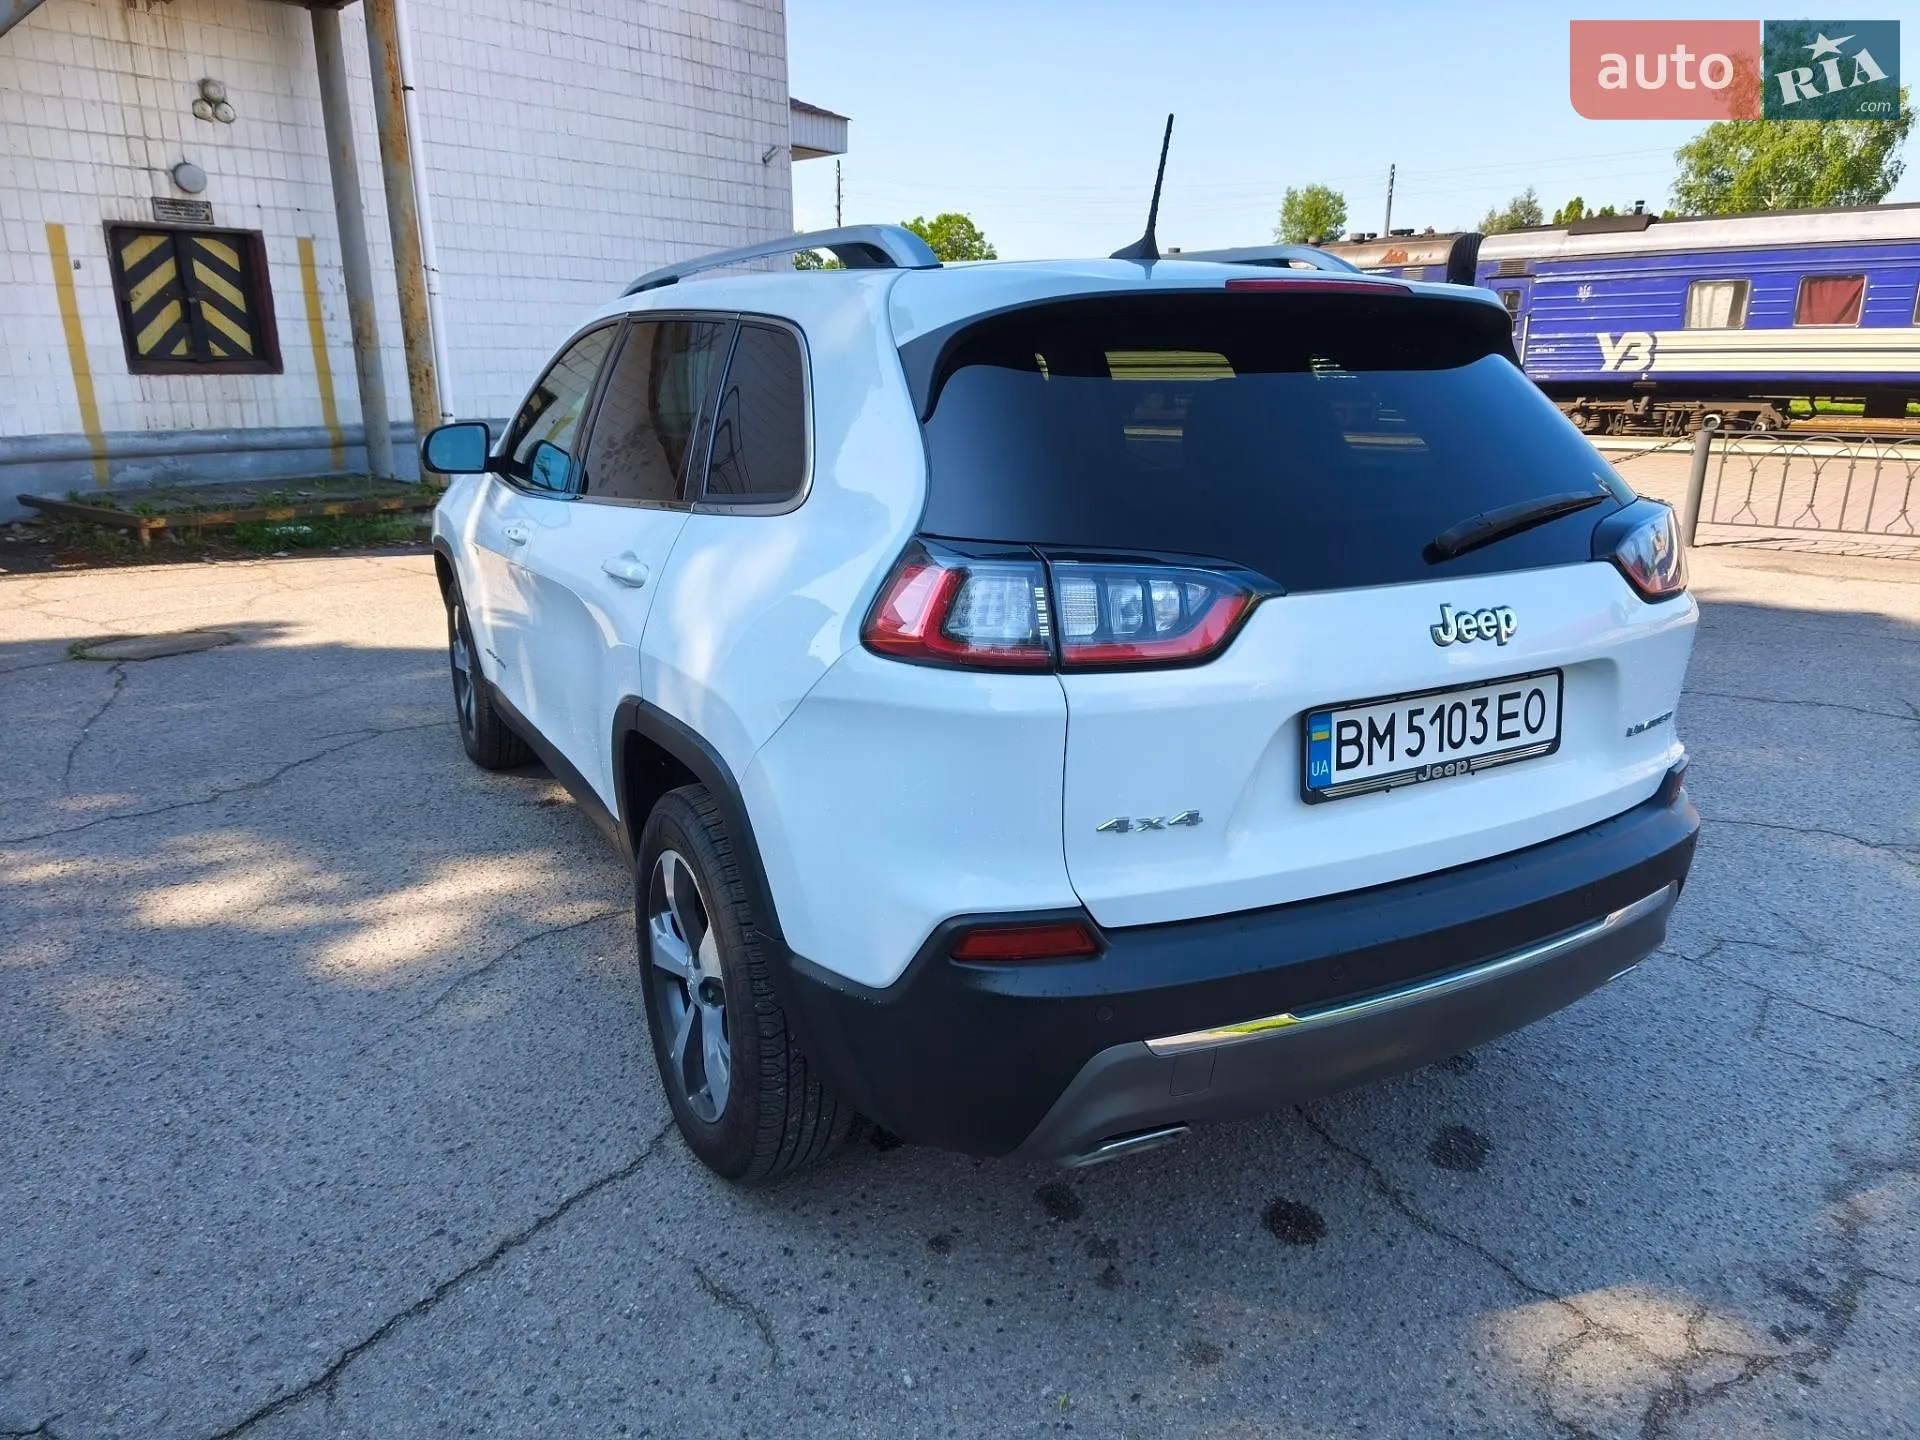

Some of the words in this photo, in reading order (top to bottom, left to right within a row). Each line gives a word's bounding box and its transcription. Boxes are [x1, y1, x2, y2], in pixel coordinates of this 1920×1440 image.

[1430, 602, 1518, 647] Jeep
[1311, 759, 1329, 777] UA
[1417, 760, 1470, 782] Jeep
